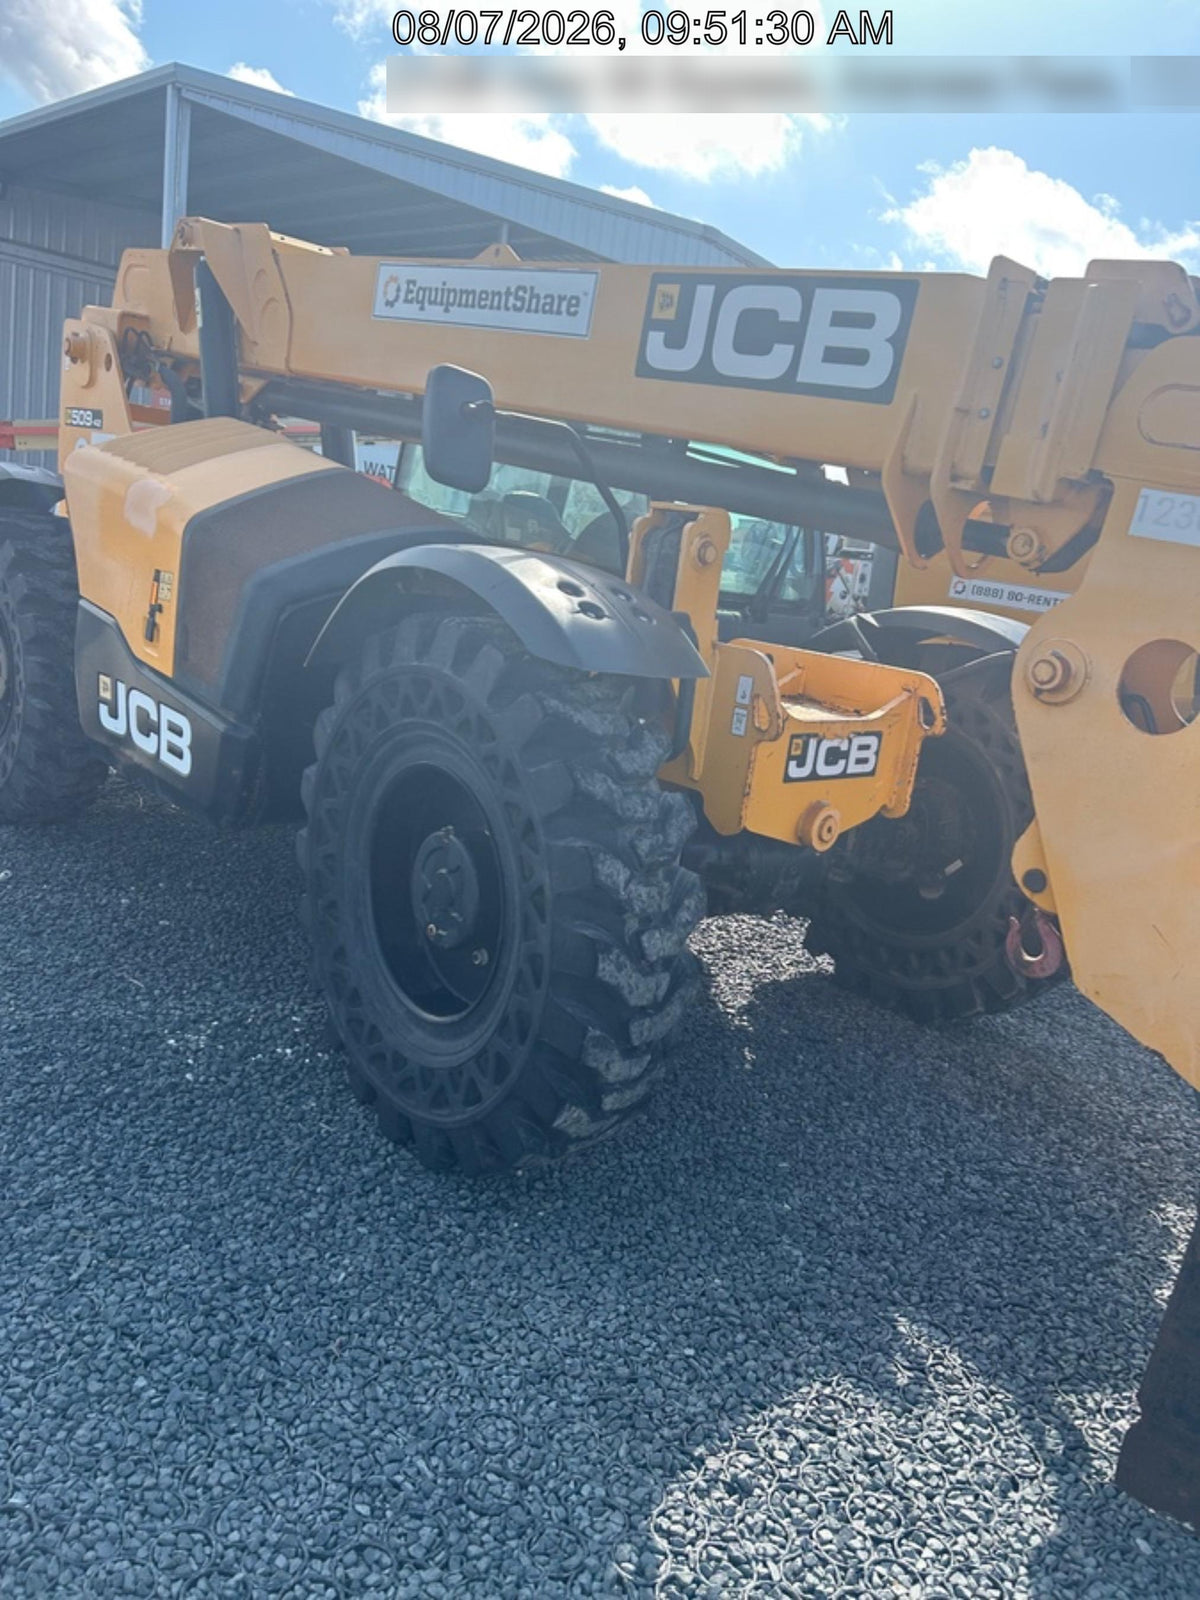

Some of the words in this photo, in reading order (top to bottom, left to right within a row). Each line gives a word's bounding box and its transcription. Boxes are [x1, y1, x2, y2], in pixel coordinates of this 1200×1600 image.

[403, 278, 580, 317] EquipmentShare
[645, 283, 902, 389] JCB
[1138, 494, 1200, 532] 123
[1006, 590, 1064, 607] 80-RENT
[98, 679, 192, 777] JCB
[786, 735, 879, 779] JCB
